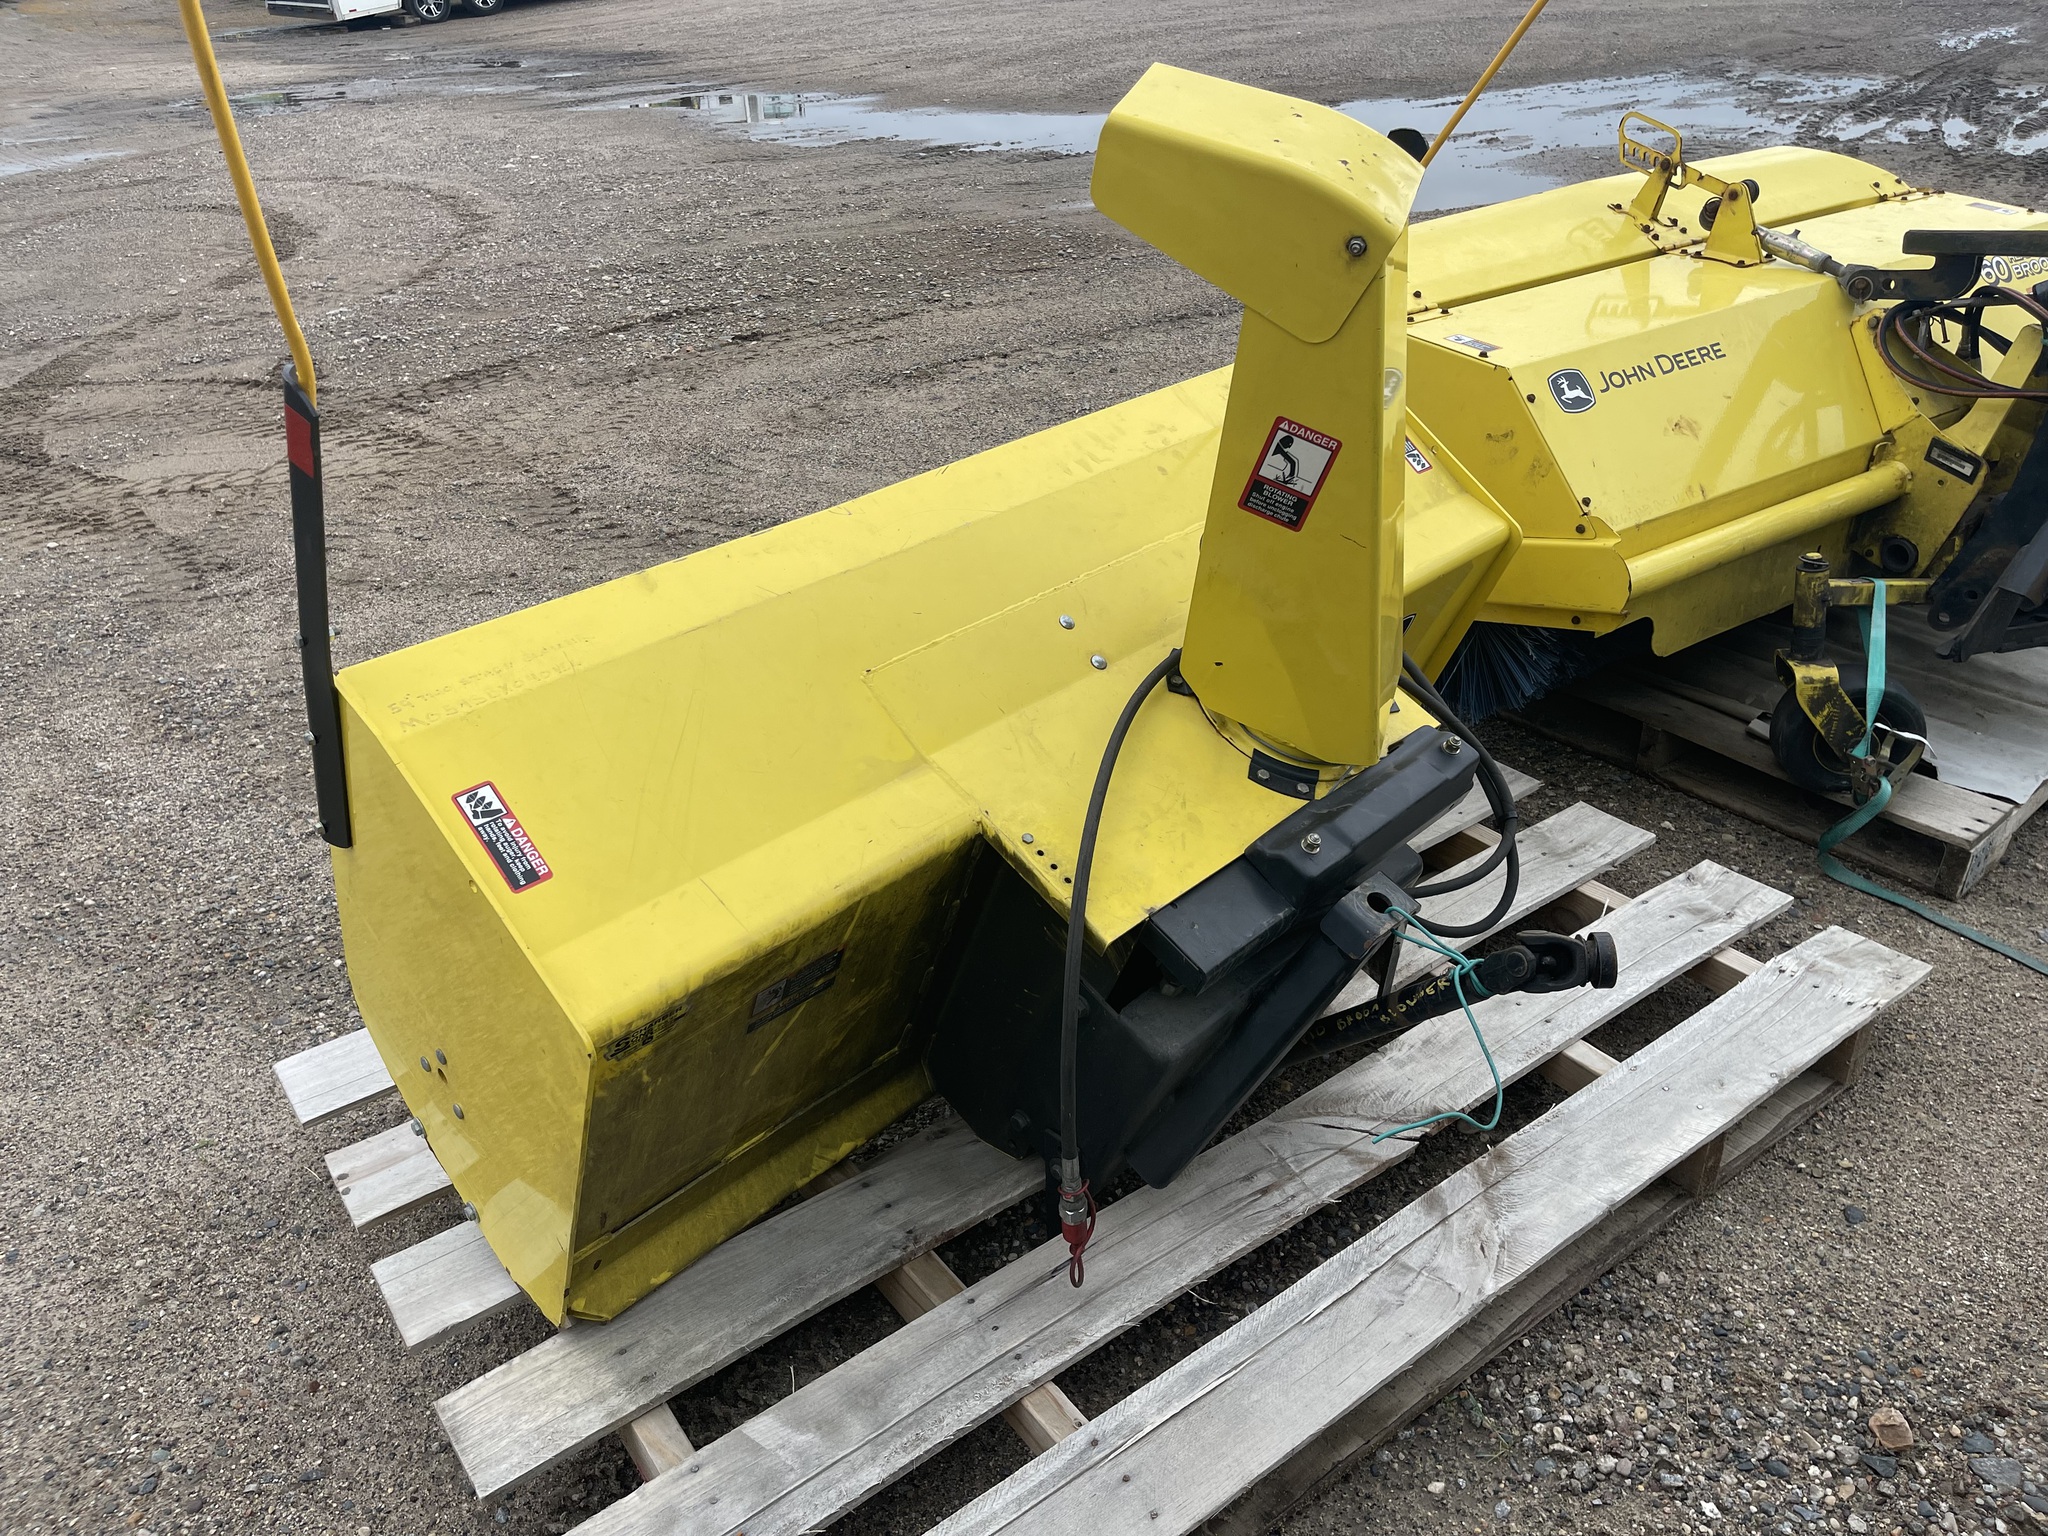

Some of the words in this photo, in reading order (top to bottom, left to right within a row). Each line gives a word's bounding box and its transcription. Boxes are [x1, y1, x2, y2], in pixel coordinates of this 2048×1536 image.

[1981, 255, 2012, 287] 60
[1599, 361, 1657, 394] JOHN
[1653, 342, 1727, 376] DEERE
[1290, 424, 1338, 450] DANGER
[1251, 491, 1266, 501] Shut
[1266, 497, 1275, 505] off
[1275, 502, 1295, 513] engine
[1262, 490, 1294, 507] BLOWER
[1263, 484, 1298, 503] ROTATING
[1247, 501, 1274, 516] discharge
[1249, 496, 1267, 507] before
[1267, 504, 1298, 521] unclogging
[483, 823, 497, 843] hands,
[495, 841, 506, 853] feet
[502, 852, 513, 864] and
[509, 863, 527, 886] clothing
[489, 821, 506, 842] rotating
[514, 858, 526, 873] keep
[495, 818, 503, 827] To
[500, 826, 514, 842] avoid
[510, 840, 523, 857] injury
[520, 856, 531, 870] from
[510, 827, 549, 876] DANGER
